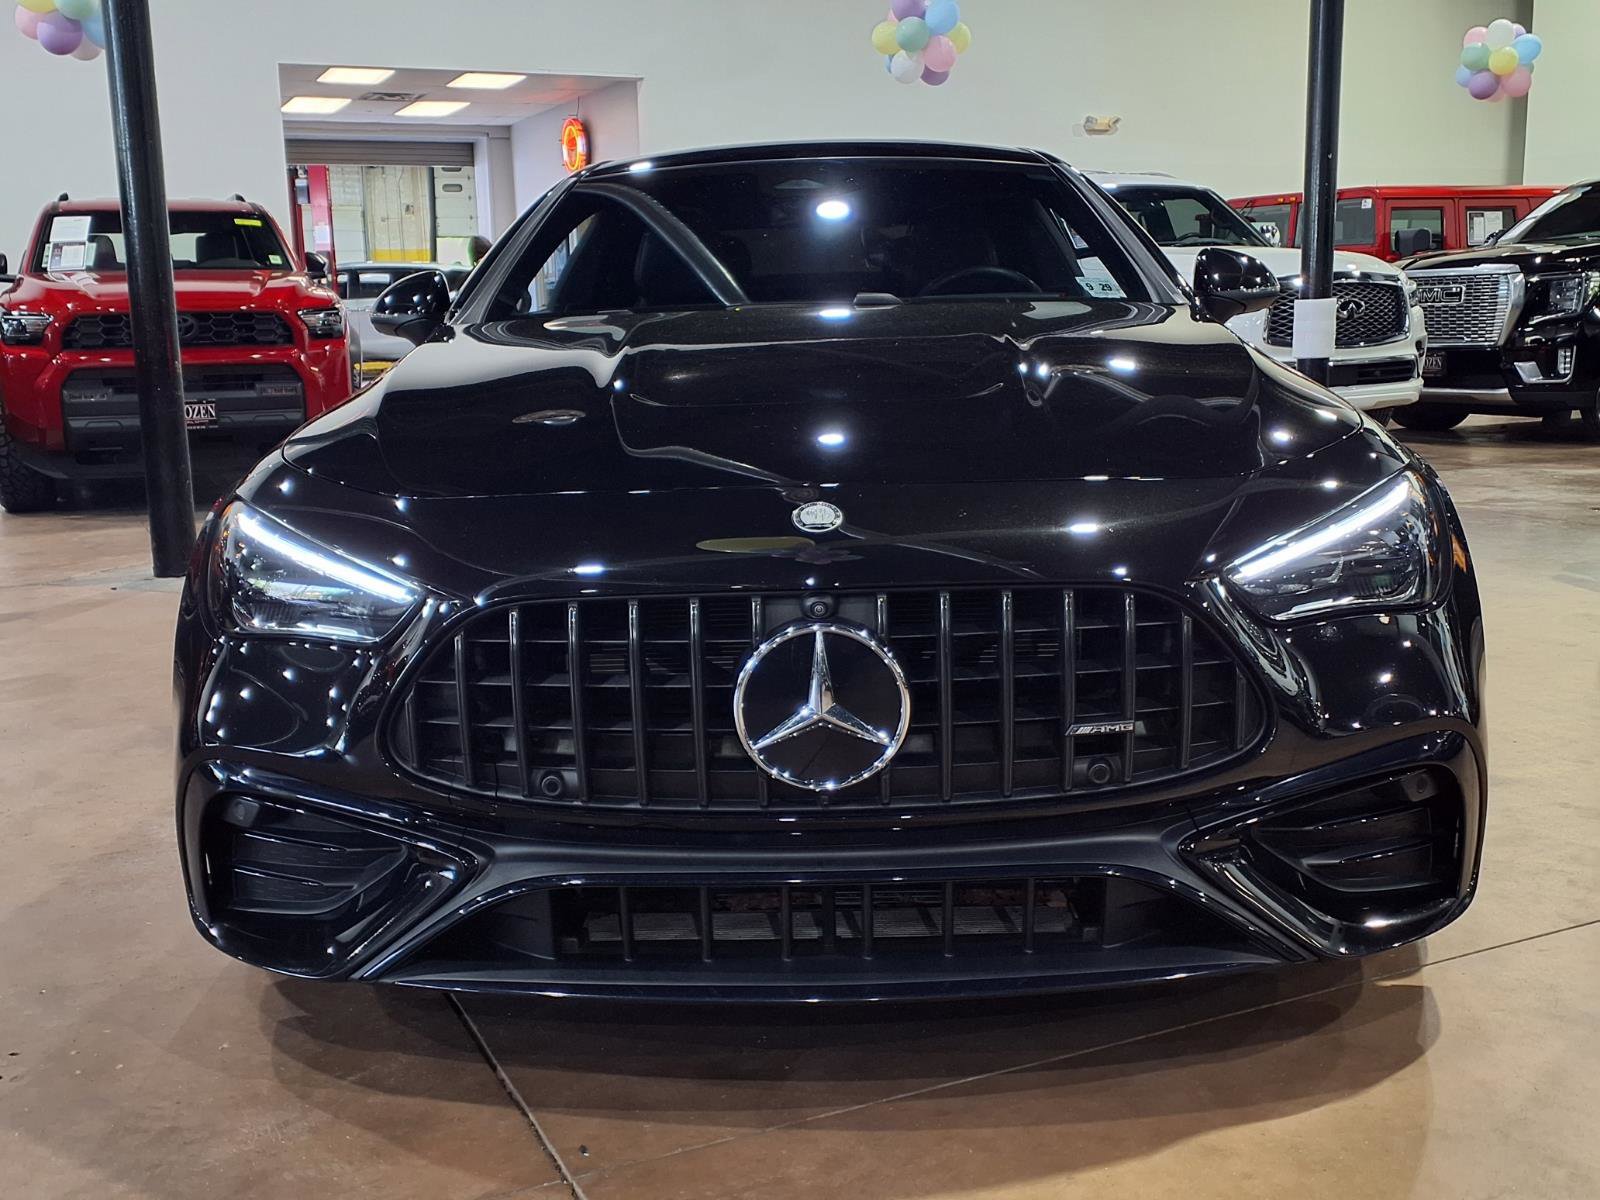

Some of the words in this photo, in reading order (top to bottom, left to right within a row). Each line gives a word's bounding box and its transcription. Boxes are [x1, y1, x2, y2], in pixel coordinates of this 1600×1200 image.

[1085, 282, 1094, 291] 9
[1098, 283, 1112, 291] 29
[1411, 287, 1460, 302] MC
[184, 404, 216, 419] OZEN
